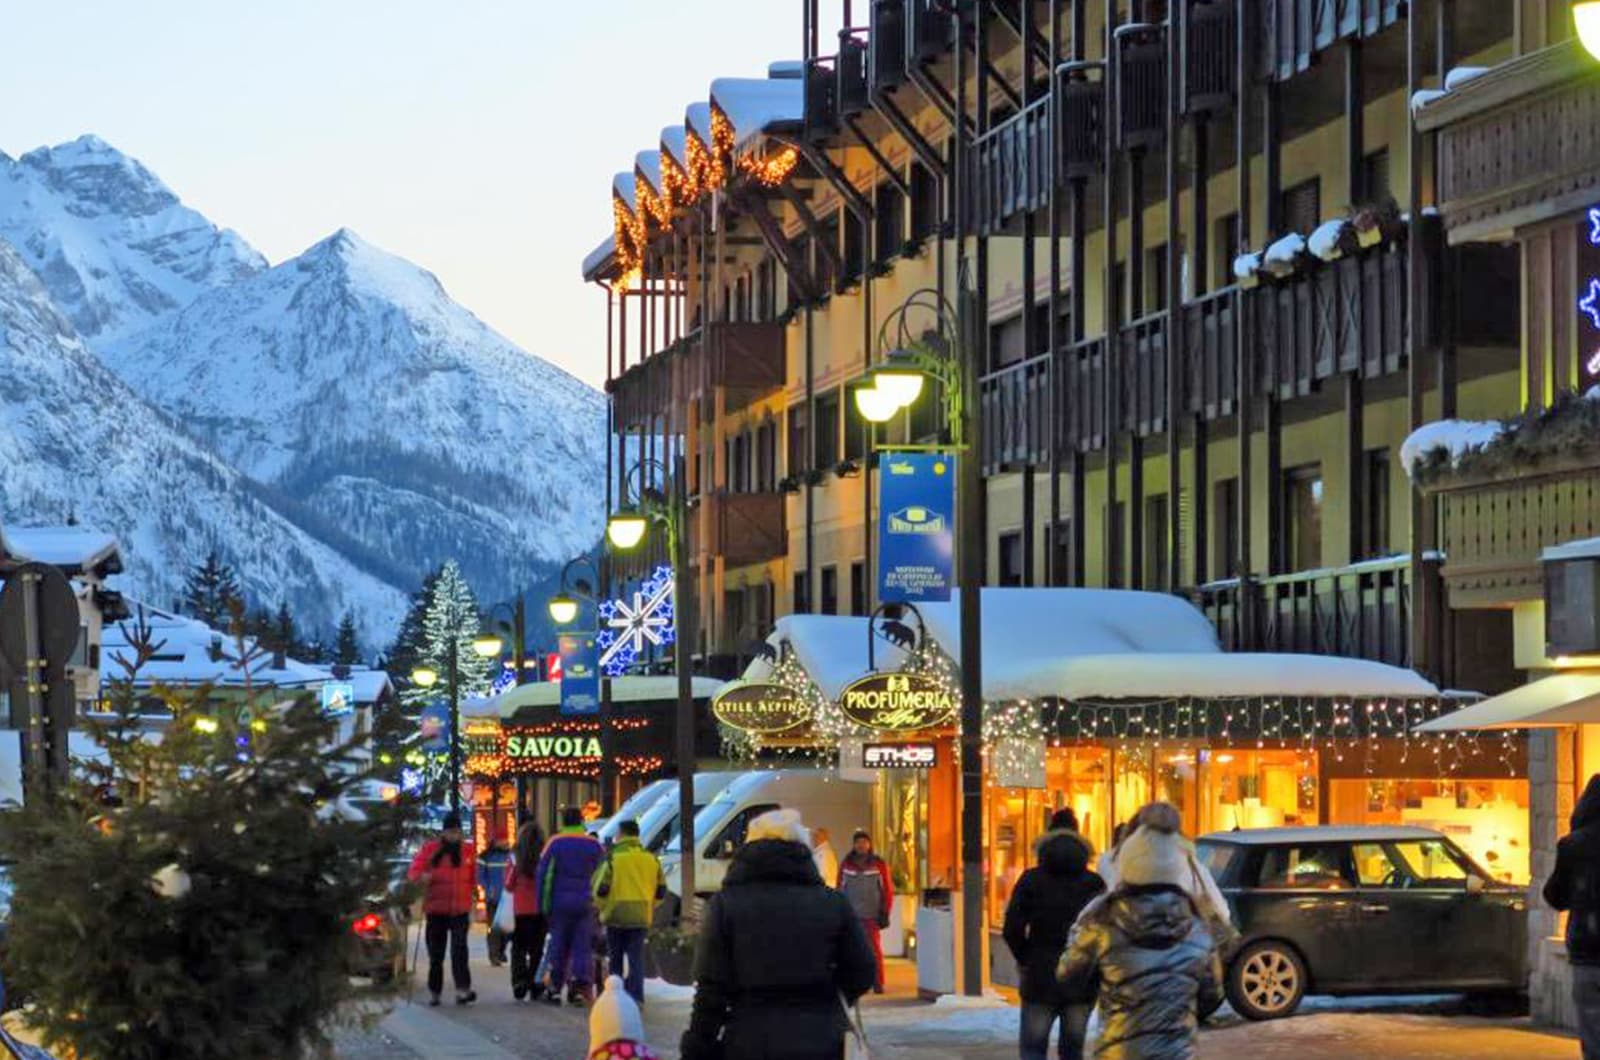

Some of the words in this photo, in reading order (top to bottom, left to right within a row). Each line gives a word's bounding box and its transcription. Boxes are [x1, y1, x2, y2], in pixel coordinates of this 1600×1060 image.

[847, 690, 952, 709] PROFUMERIA
[507, 737, 603, 757] SAVOIA
[865, 747, 935, 762] ETHOS
